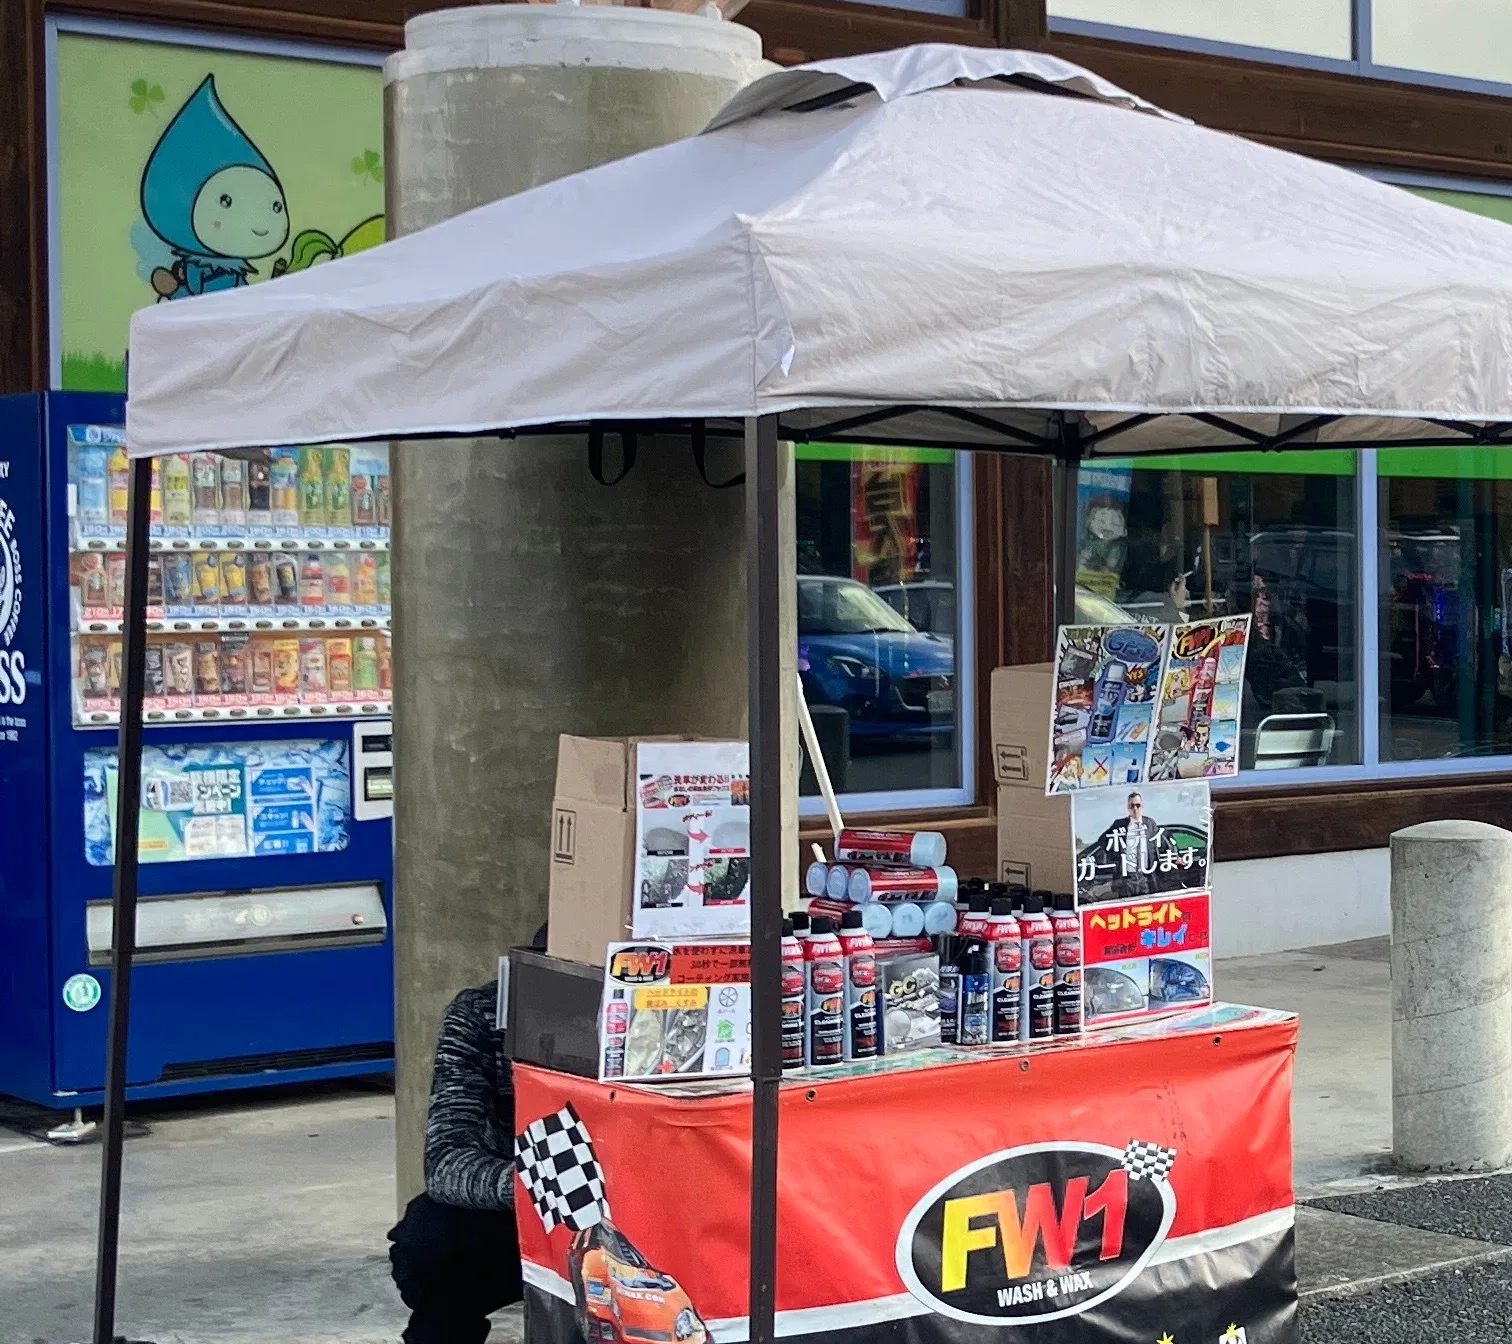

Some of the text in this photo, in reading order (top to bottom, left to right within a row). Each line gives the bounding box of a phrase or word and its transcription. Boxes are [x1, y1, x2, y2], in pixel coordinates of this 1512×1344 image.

[1077, 845, 1207, 883] ガードします。
[611, 951, 668, 977] FW1
[941, 1168, 1130, 1294] FW1
[996, 1270, 1095, 1308] WASH & WAX
